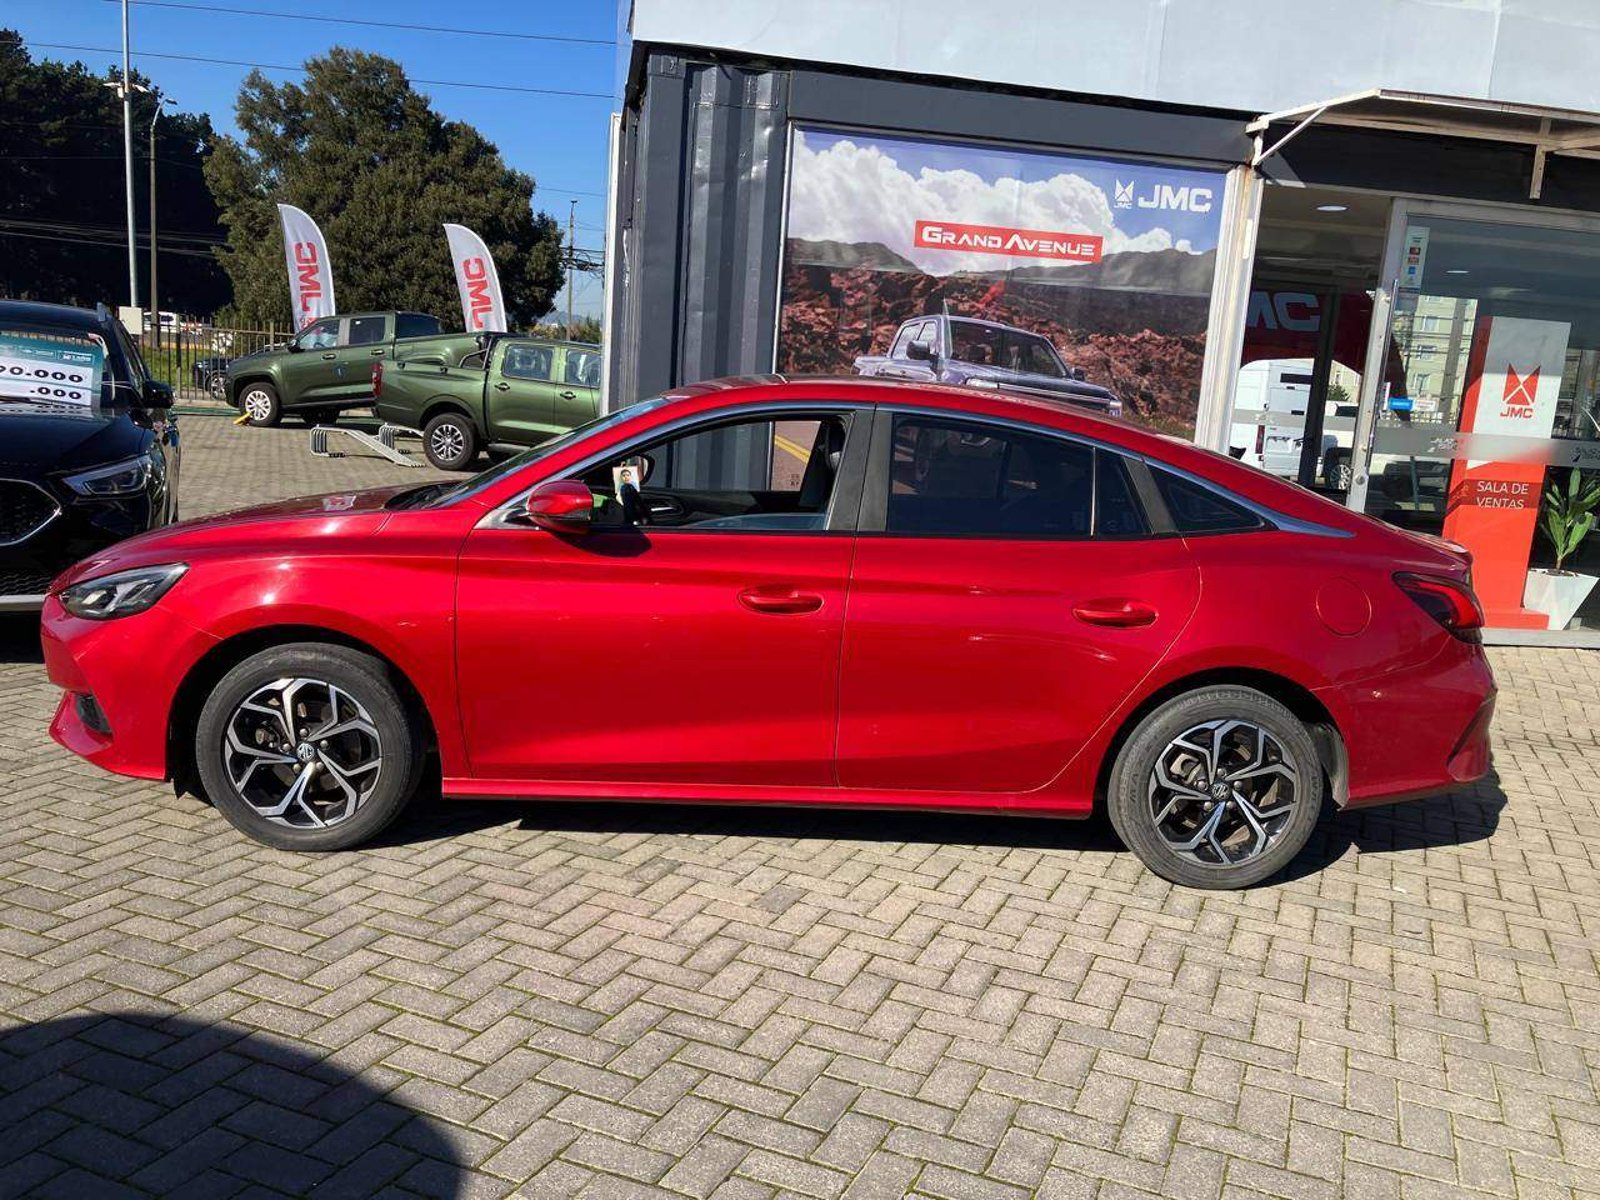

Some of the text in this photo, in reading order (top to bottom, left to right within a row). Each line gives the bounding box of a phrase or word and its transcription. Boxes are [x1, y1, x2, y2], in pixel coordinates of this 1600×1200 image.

[1139, 184, 1212, 212] JMC
[921, 225, 1095, 256] GRAND AVENUE
[1247, 290, 1321, 332] MC
[1500, 407, 1534, 419] JMC
[1477, 480, 1509, 493] SALA
[1511, 483, 1529, 495] DE
[1476, 496, 1525, 509] VENTAS
